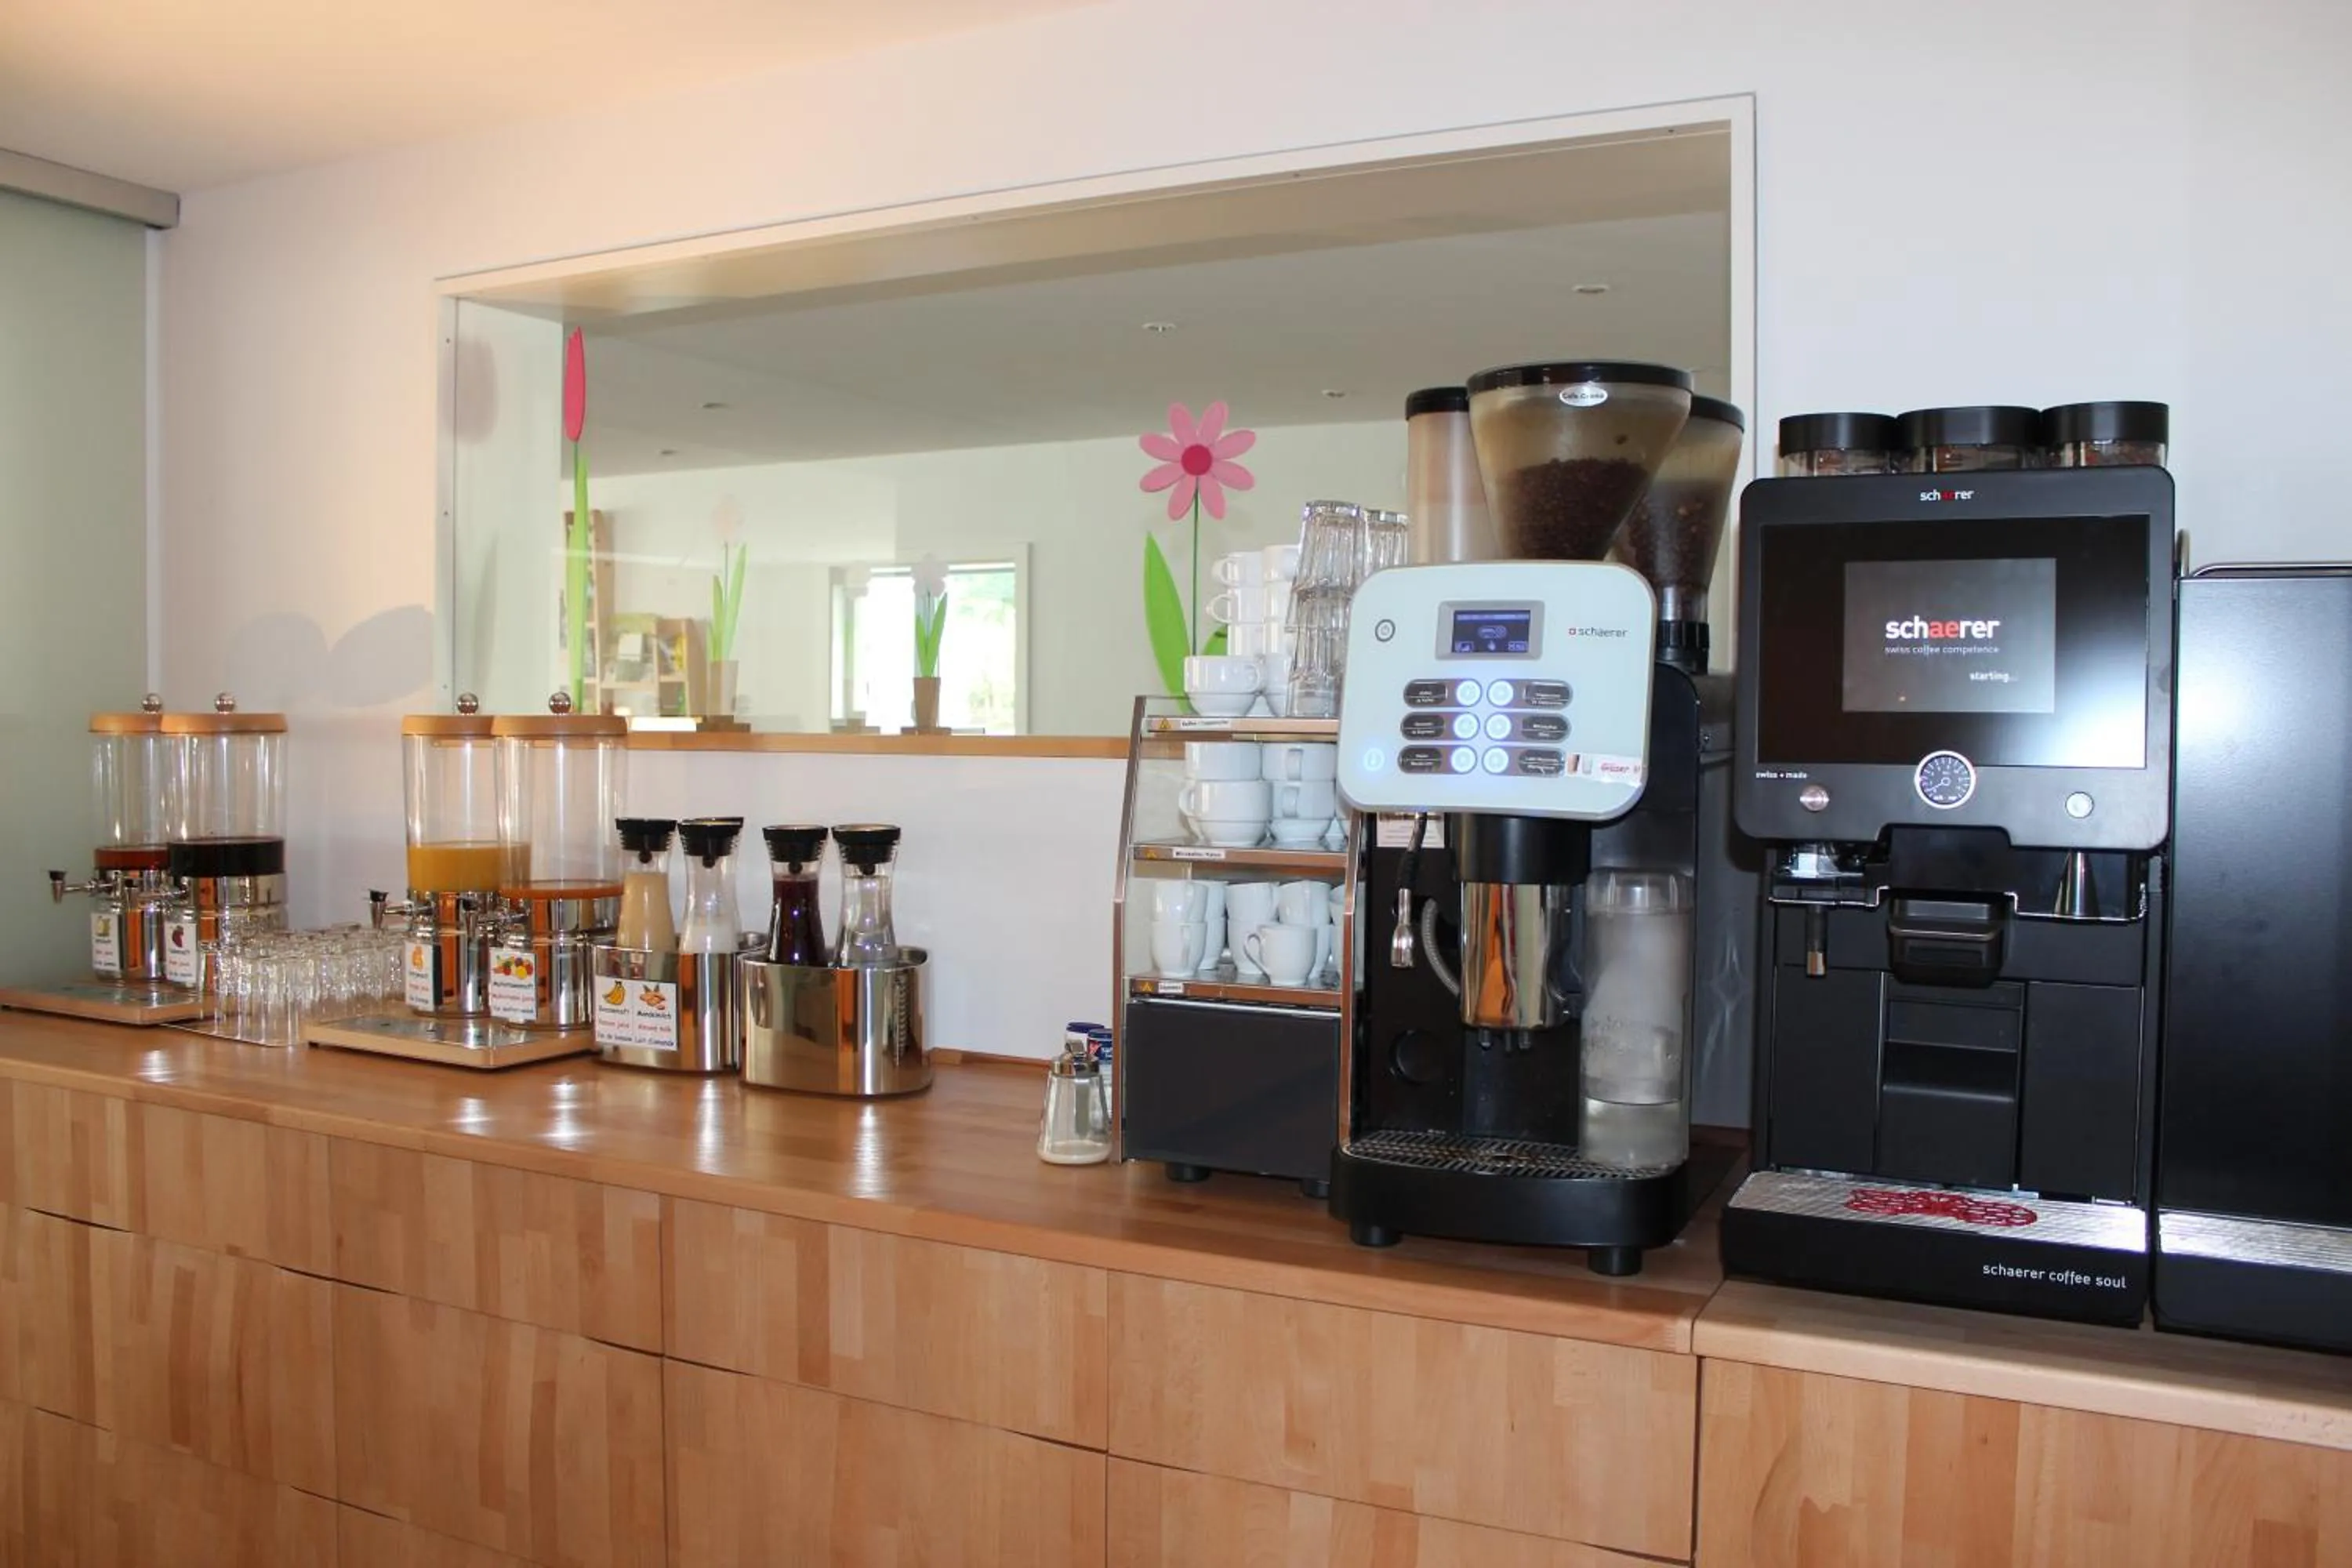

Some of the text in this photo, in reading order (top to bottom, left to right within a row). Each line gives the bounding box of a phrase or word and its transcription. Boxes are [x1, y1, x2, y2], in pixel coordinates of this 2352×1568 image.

[1919, 488, 1975, 501] schaerer
[1885, 615, 2002, 639] schaerer
[1885, 644, 1999, 656] swiss coffee competence
[1983, 1263, 2127, 1288] schaerer coffee soul
